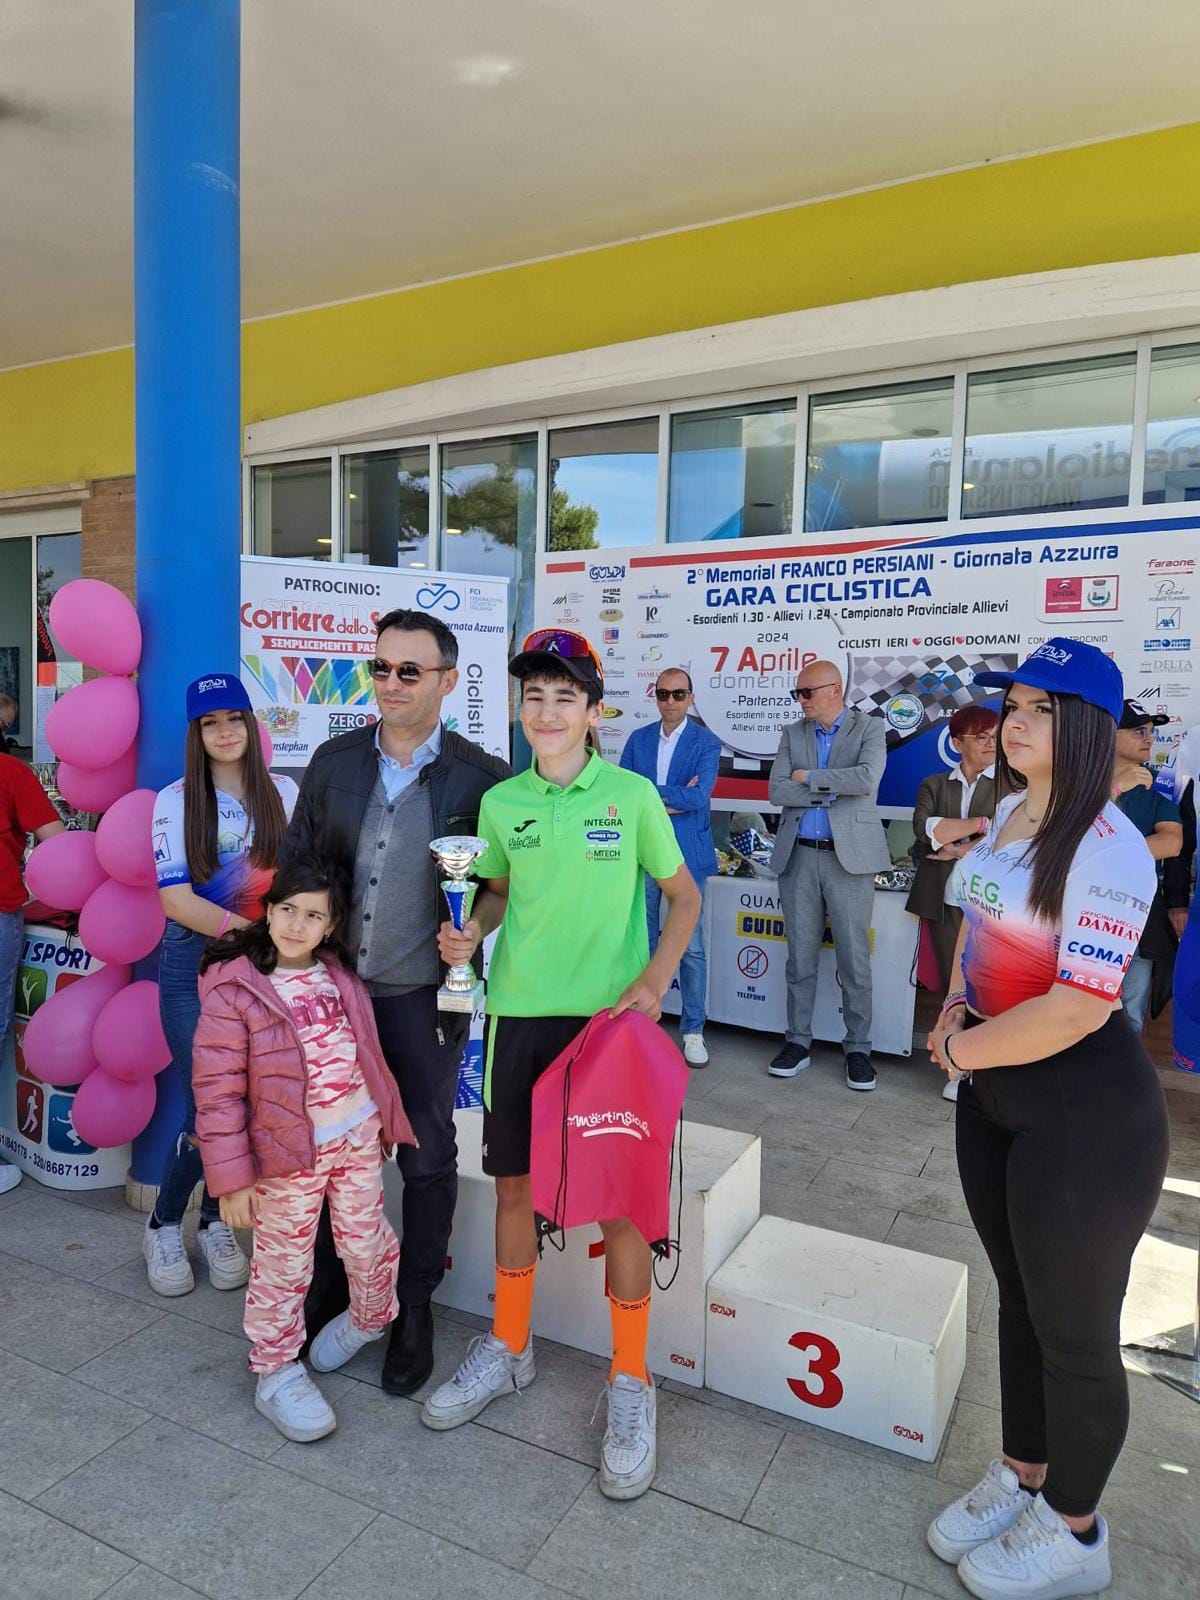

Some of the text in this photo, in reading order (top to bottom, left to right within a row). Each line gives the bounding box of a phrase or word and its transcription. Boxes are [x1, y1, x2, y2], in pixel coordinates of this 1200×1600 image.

[706, 564, 775, 584] Memorial
[781, 559, 847, 579] FRANCO
[853, 553, 934, 575] PERSIANI
[953, 547, 1032, 568] Giornata
[1039, 545, 1119, 563] Azzurra
[284, 577, 380, 596] PATROCINIO:
[706, 577, 932, 607] GARA CICLISTICA
[240, 602, 335, 633] Corriere
[336, 617, 369, 634] dello
[693, 612, 738, 625] Esordienti
[773, 609, 803, 622] Allievi
[841, 605, 903, 621] Campionato
[907, 603, 968, 616] Provinciale
[972, 600, 1009, 613] Allievi
[474, 622, 504, 633] Azzurra
[271, 638, 353, 651] SEMPLICEMENTE
[757, 633, 789, 643] 2024
[838, 634, 1021, 649] CICLISTI IERI OGGI DOMANI
[1027, 636, 1045, 645] CON
[1065, 635, 1108, 643] ATROCINIO
[710, 646, 817, 676] 7 Aprile
[1154, 660, 1192, 668] DELTA
[709, 672, 799, 689] domenic
[467, 663, 484, 734] Ciclisti
[726, 710, 765, 719] Esordienti
[767, 711, 780, 719] ore
[731, 723, 755, 732] Allievi
[757, 724, 771, 732] ore
[272, 740, 309, 752] nstephan
[1156, 776, 1175, 787] Gulp
[584, 818, 623, 827] INTEGRA
[742, 916, 786, 938] GUID
[1081, 910, 1141, 931] OFFICINA MECCA
[31, 942, 92, 970] SPORT
[736, 991, 766, 1002] TELEFONO
[33, 1153, 99, 1177] 320/8687129
[786, 1331, 845, 1409] 3
